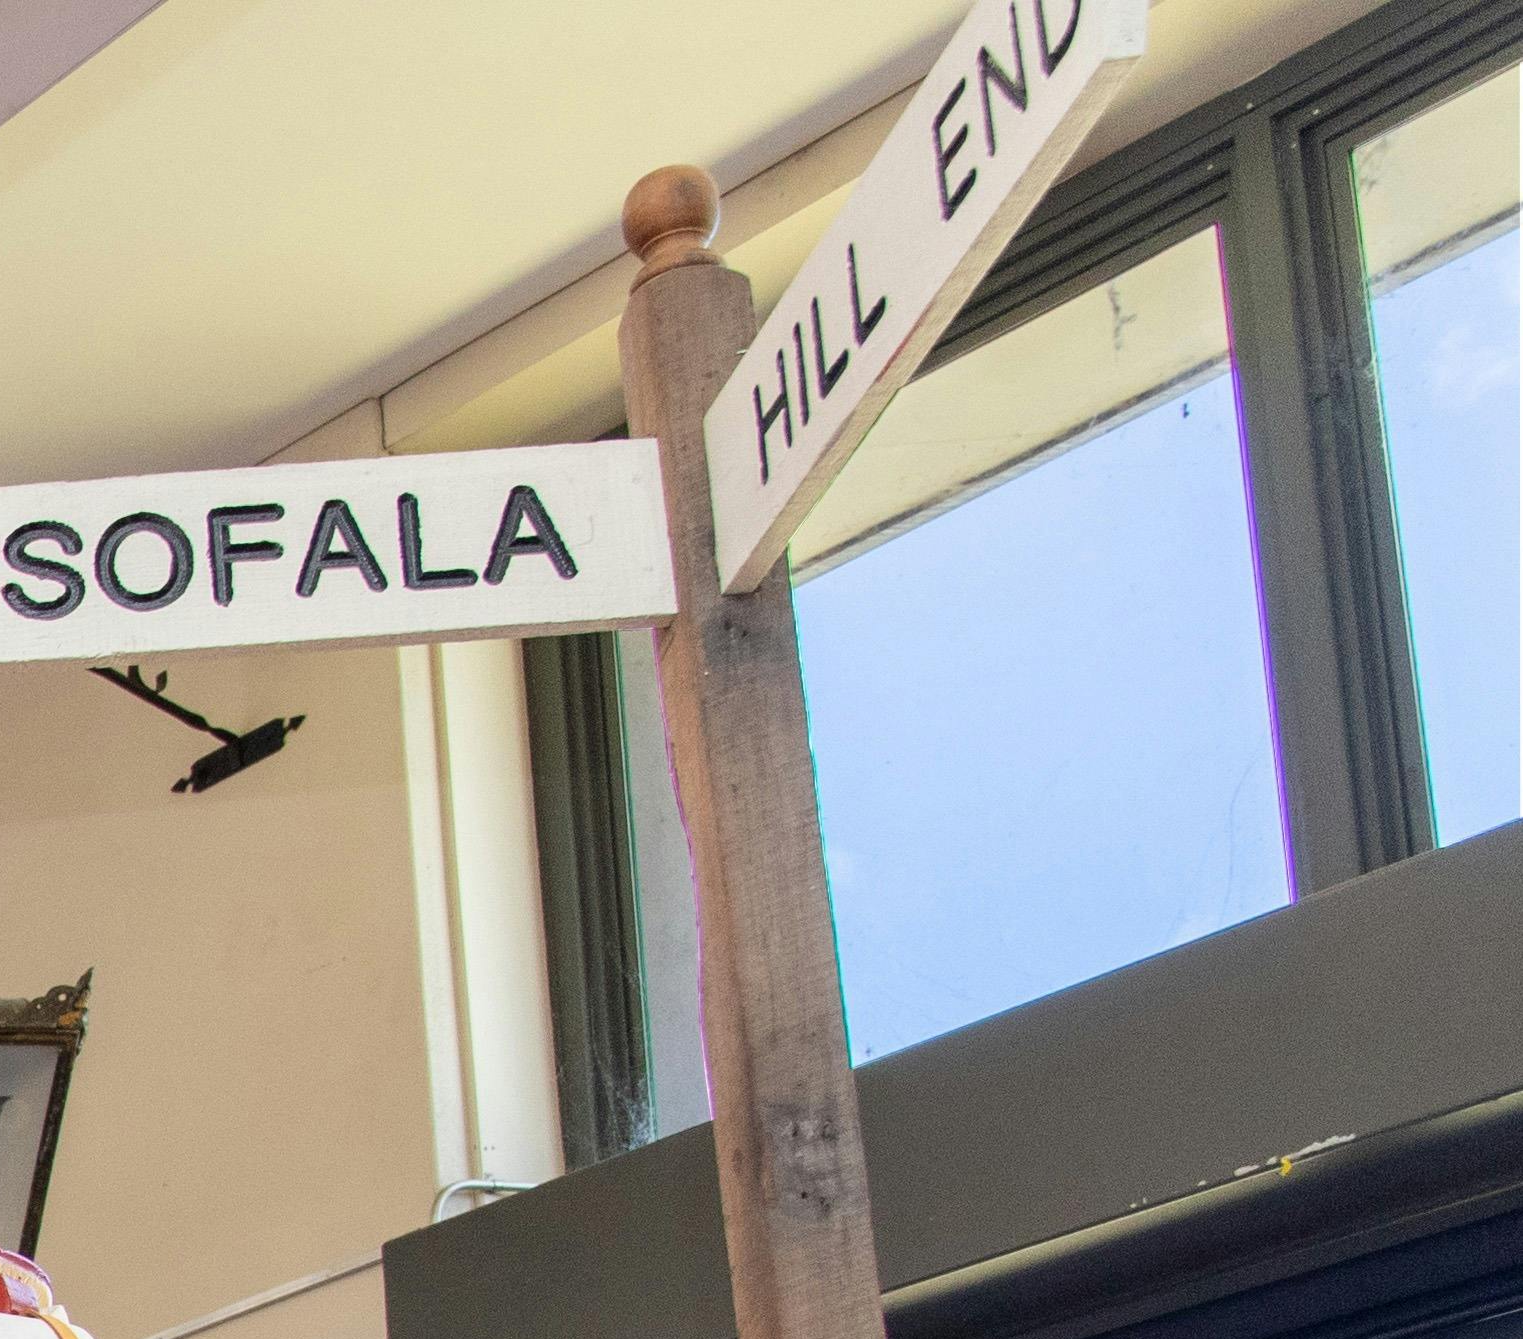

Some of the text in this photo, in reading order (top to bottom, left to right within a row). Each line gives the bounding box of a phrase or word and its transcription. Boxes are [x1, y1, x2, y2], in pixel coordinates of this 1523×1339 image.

[752, 0, 1082, 486] HILL END
[2, 485, 579, 621] SOFALA
